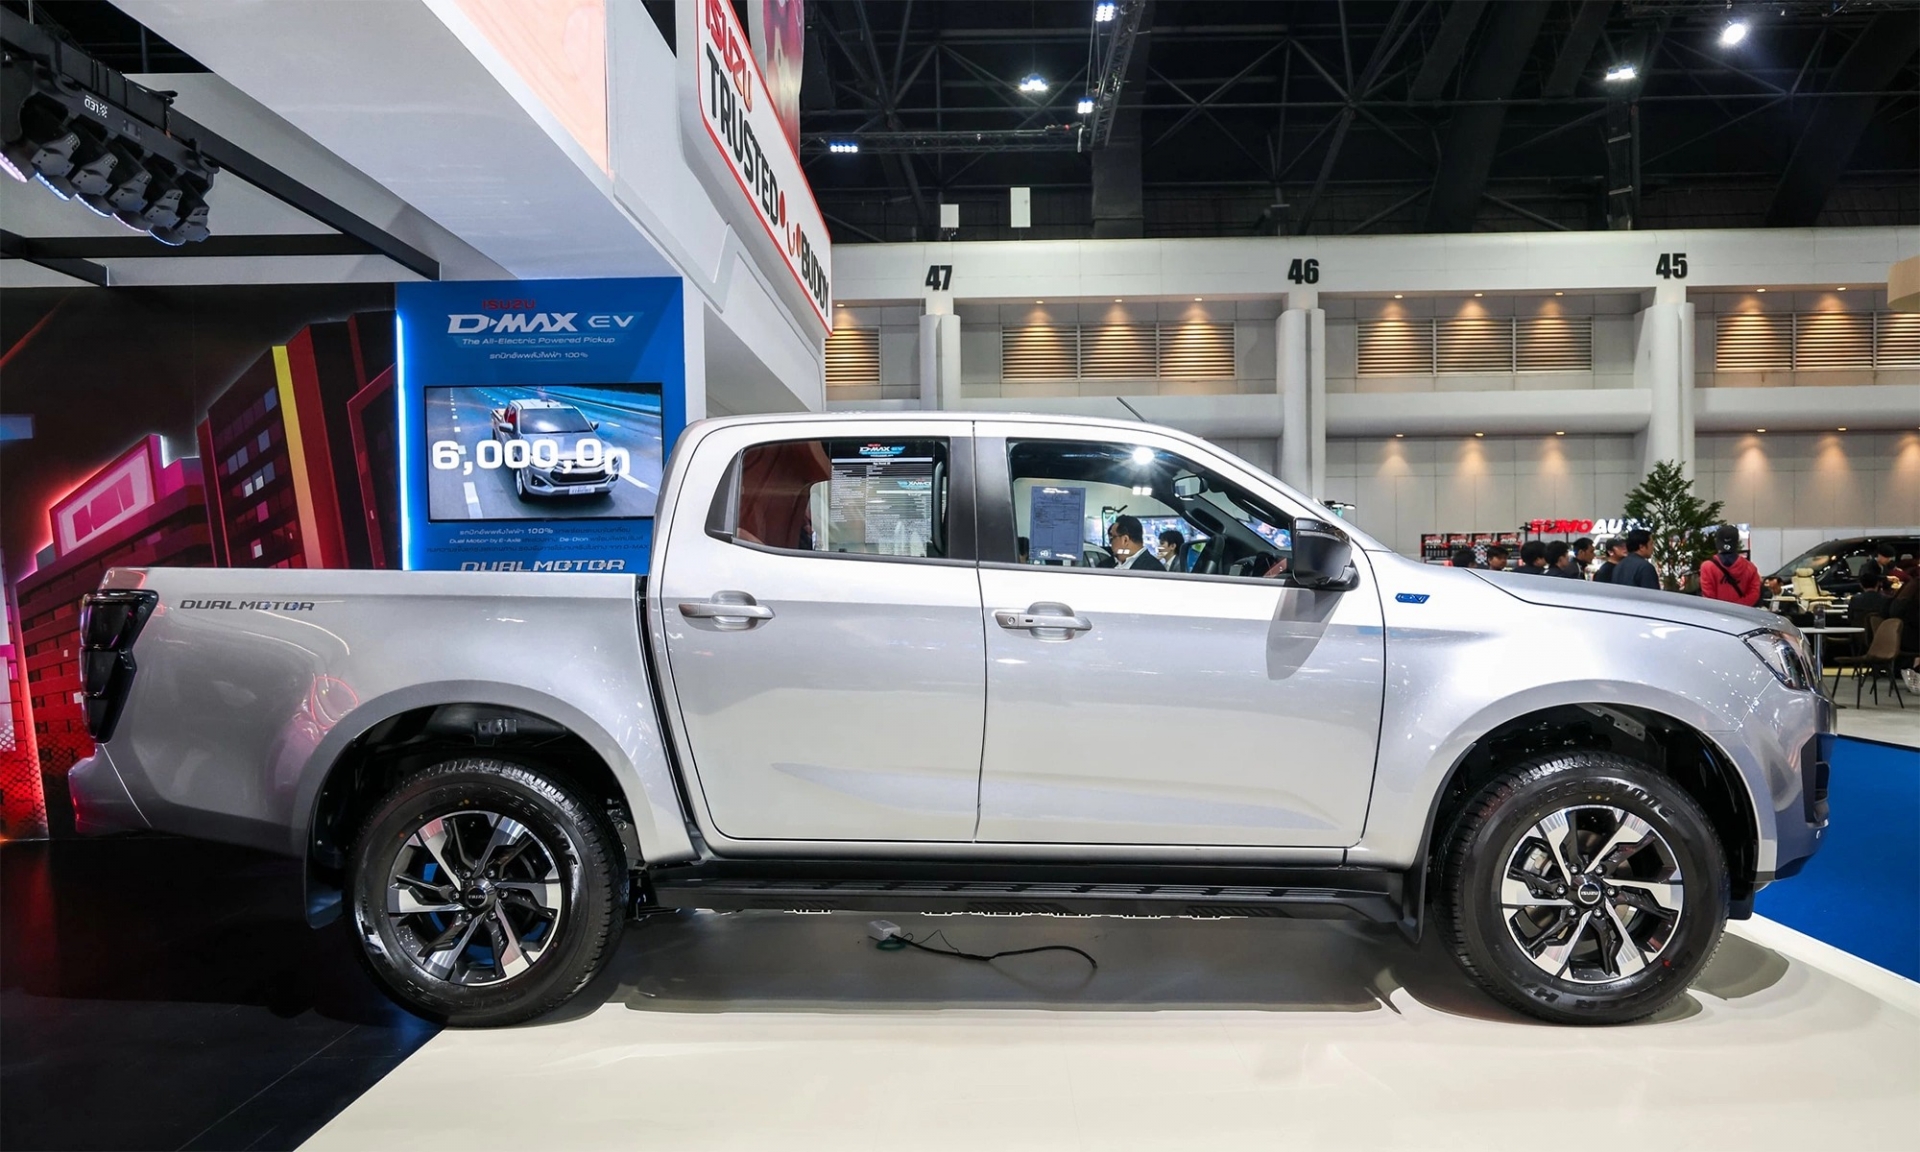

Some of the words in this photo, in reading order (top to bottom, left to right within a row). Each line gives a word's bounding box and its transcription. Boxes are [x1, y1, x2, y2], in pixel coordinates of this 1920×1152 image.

[706, 42, 778, 226] TRUSTED
[801, 230, 829, 318] BUDDY
[925, 265, 952, 291] 47
[1287, 258, 1319, 285] 46
[1656, 253, 1688, 280] 45
[482, 299, 536, 310] ISUZU
[587, 315, 635, 328] EV
[482, 337, 536, 345] All-Electric
[538, 336, 581, 344] Powered
[583, 336, 616, 344] Pickup
